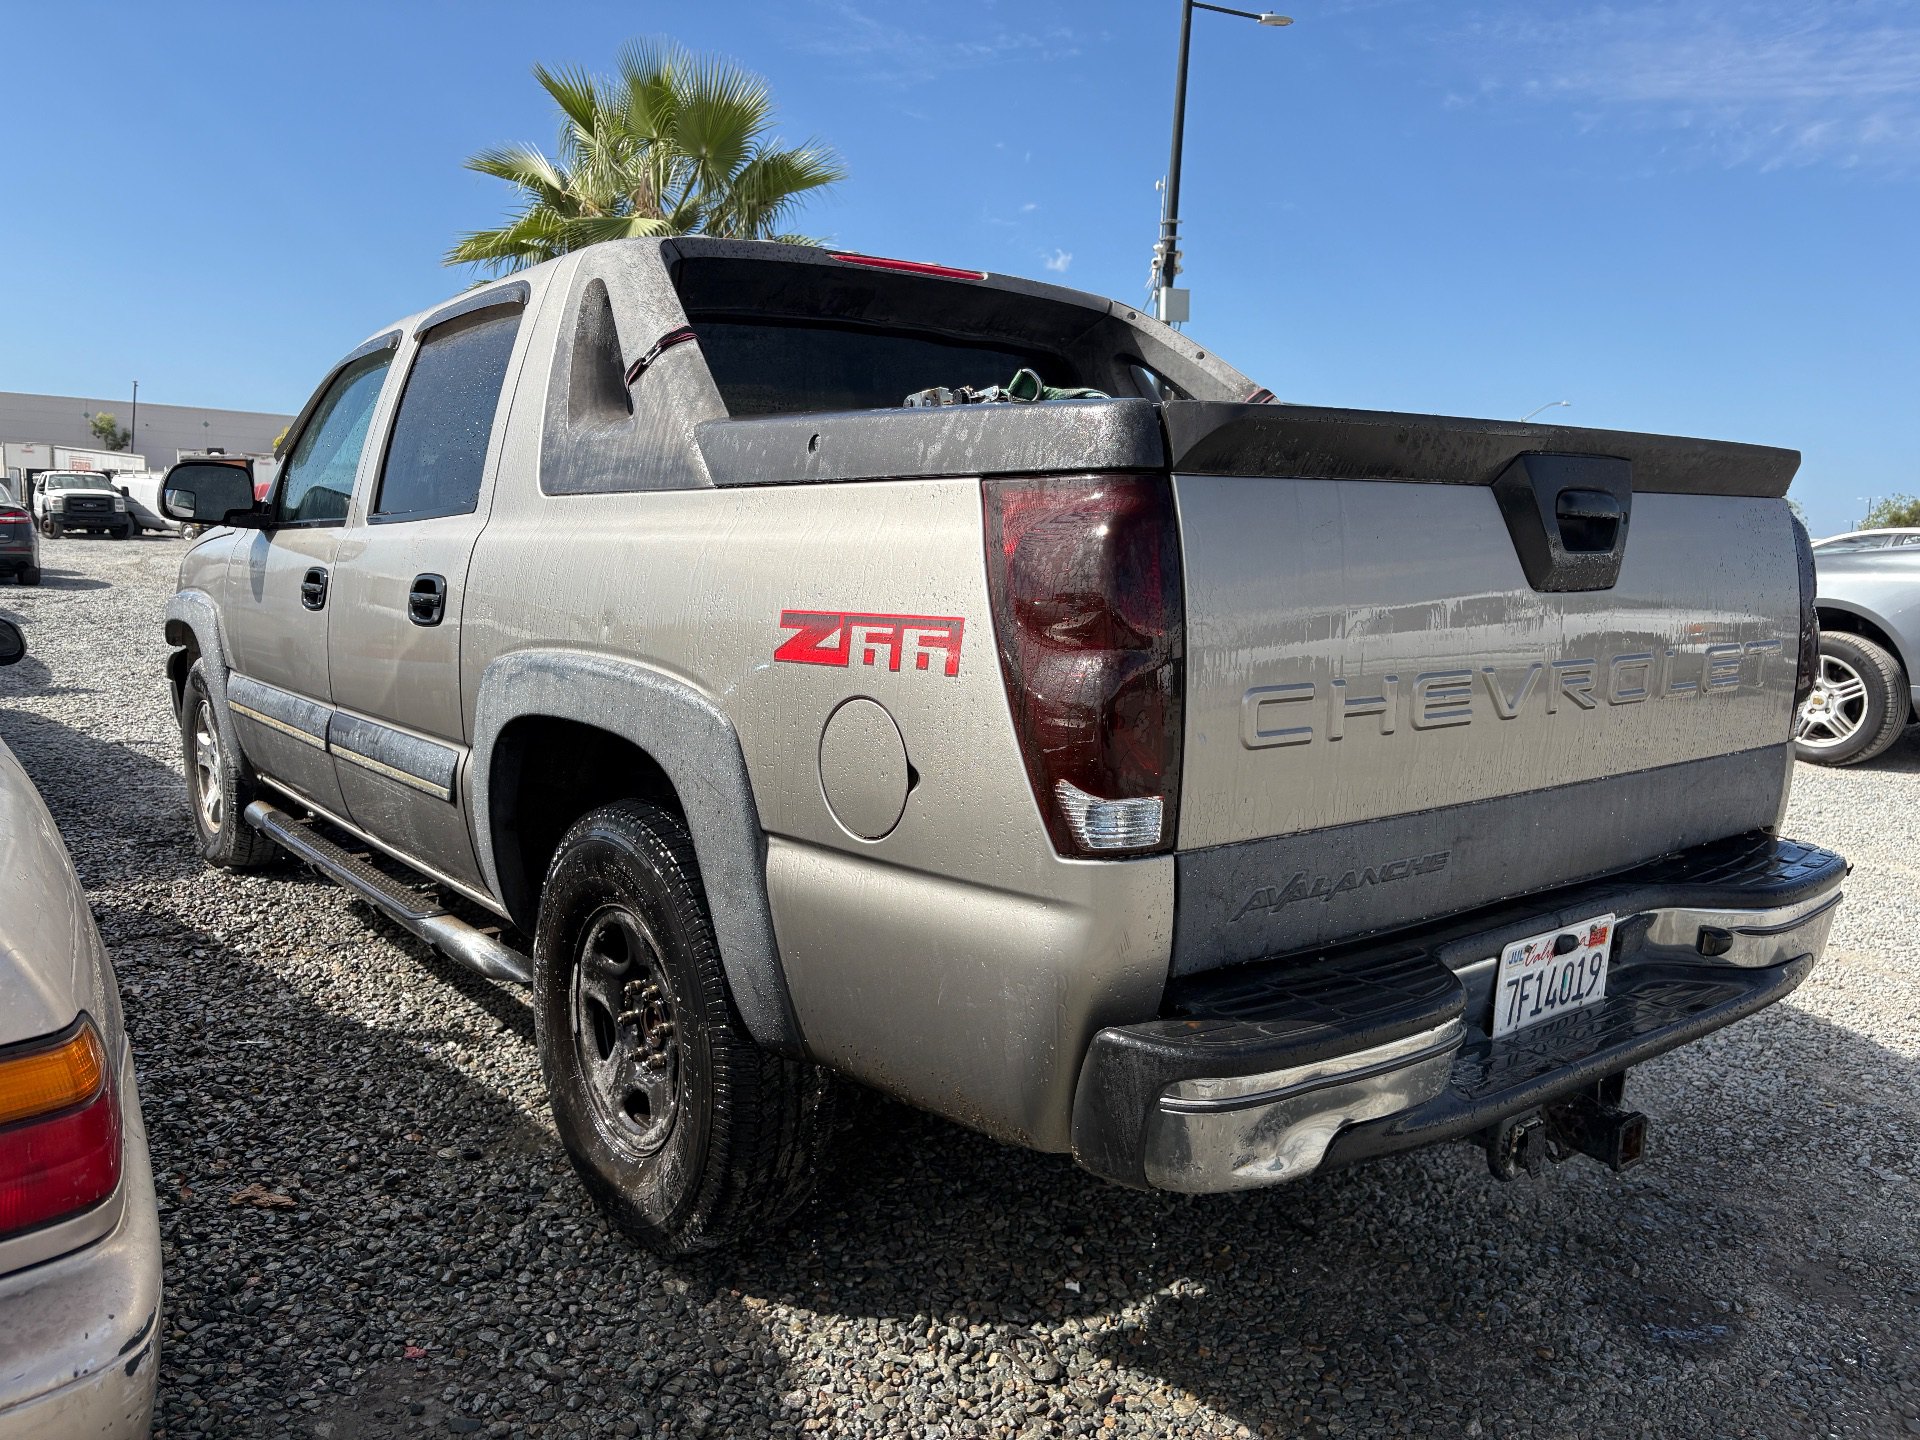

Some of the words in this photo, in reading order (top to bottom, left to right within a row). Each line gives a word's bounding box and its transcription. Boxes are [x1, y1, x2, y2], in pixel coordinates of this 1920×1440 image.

[1240, 640, 1783, 750] CHEVROLET
[1229, 848, 1452, 922] AVALANCHE
[1507, 952, 1602, 1025] 7F14019
[1508, 950, 1524, 965] JUL
